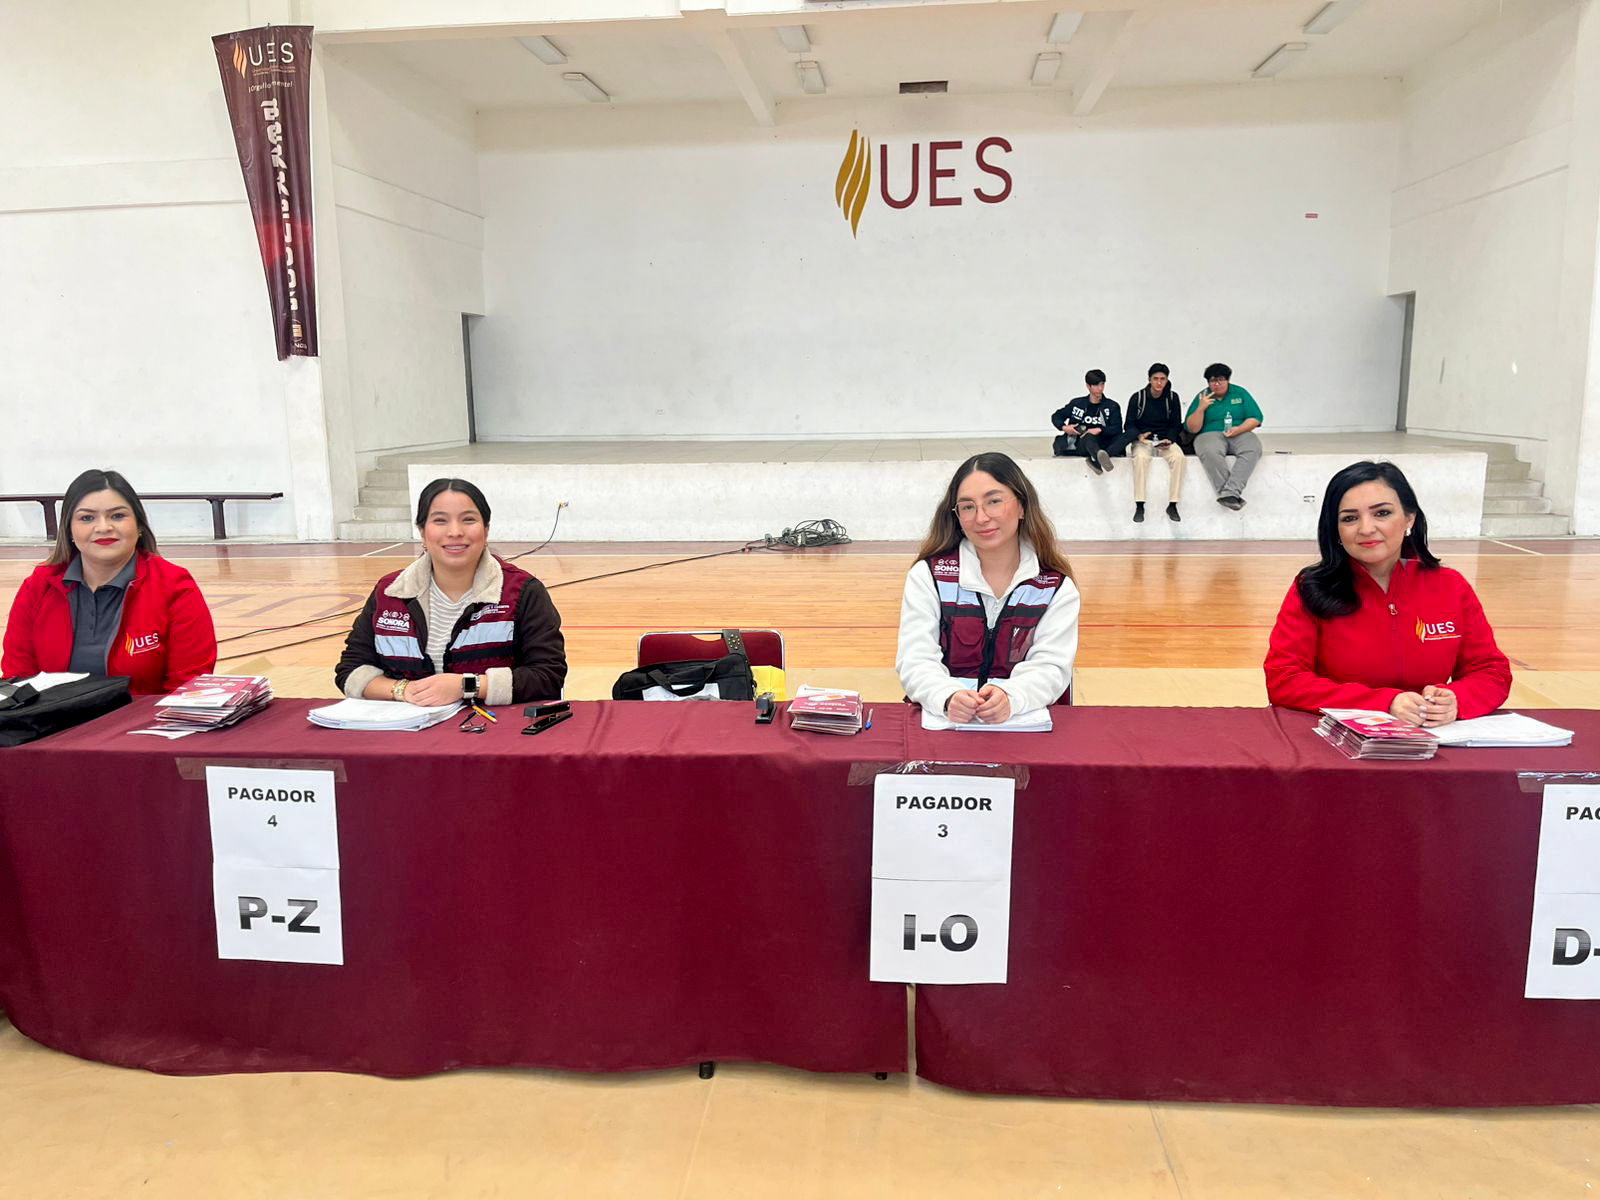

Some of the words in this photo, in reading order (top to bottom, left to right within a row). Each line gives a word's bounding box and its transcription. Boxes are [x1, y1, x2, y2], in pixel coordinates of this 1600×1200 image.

[248, 42, 294, 66] UES
[880, 136, 1013, 209] UES
[377, 616, 410, 629] SONORA
[1425, 621, 1456, 635] UES
[135, 632, 159, 648] UES
[228, 786, 317, 803] PAGADOR
[896, 796, 993, 811] PAGADOR
[267, 814, 278, 828] 4
[937, 823, 949, 838] 3
[237, 895, 321, 934] P-Z
[903, 913, 979, 952] I-O
